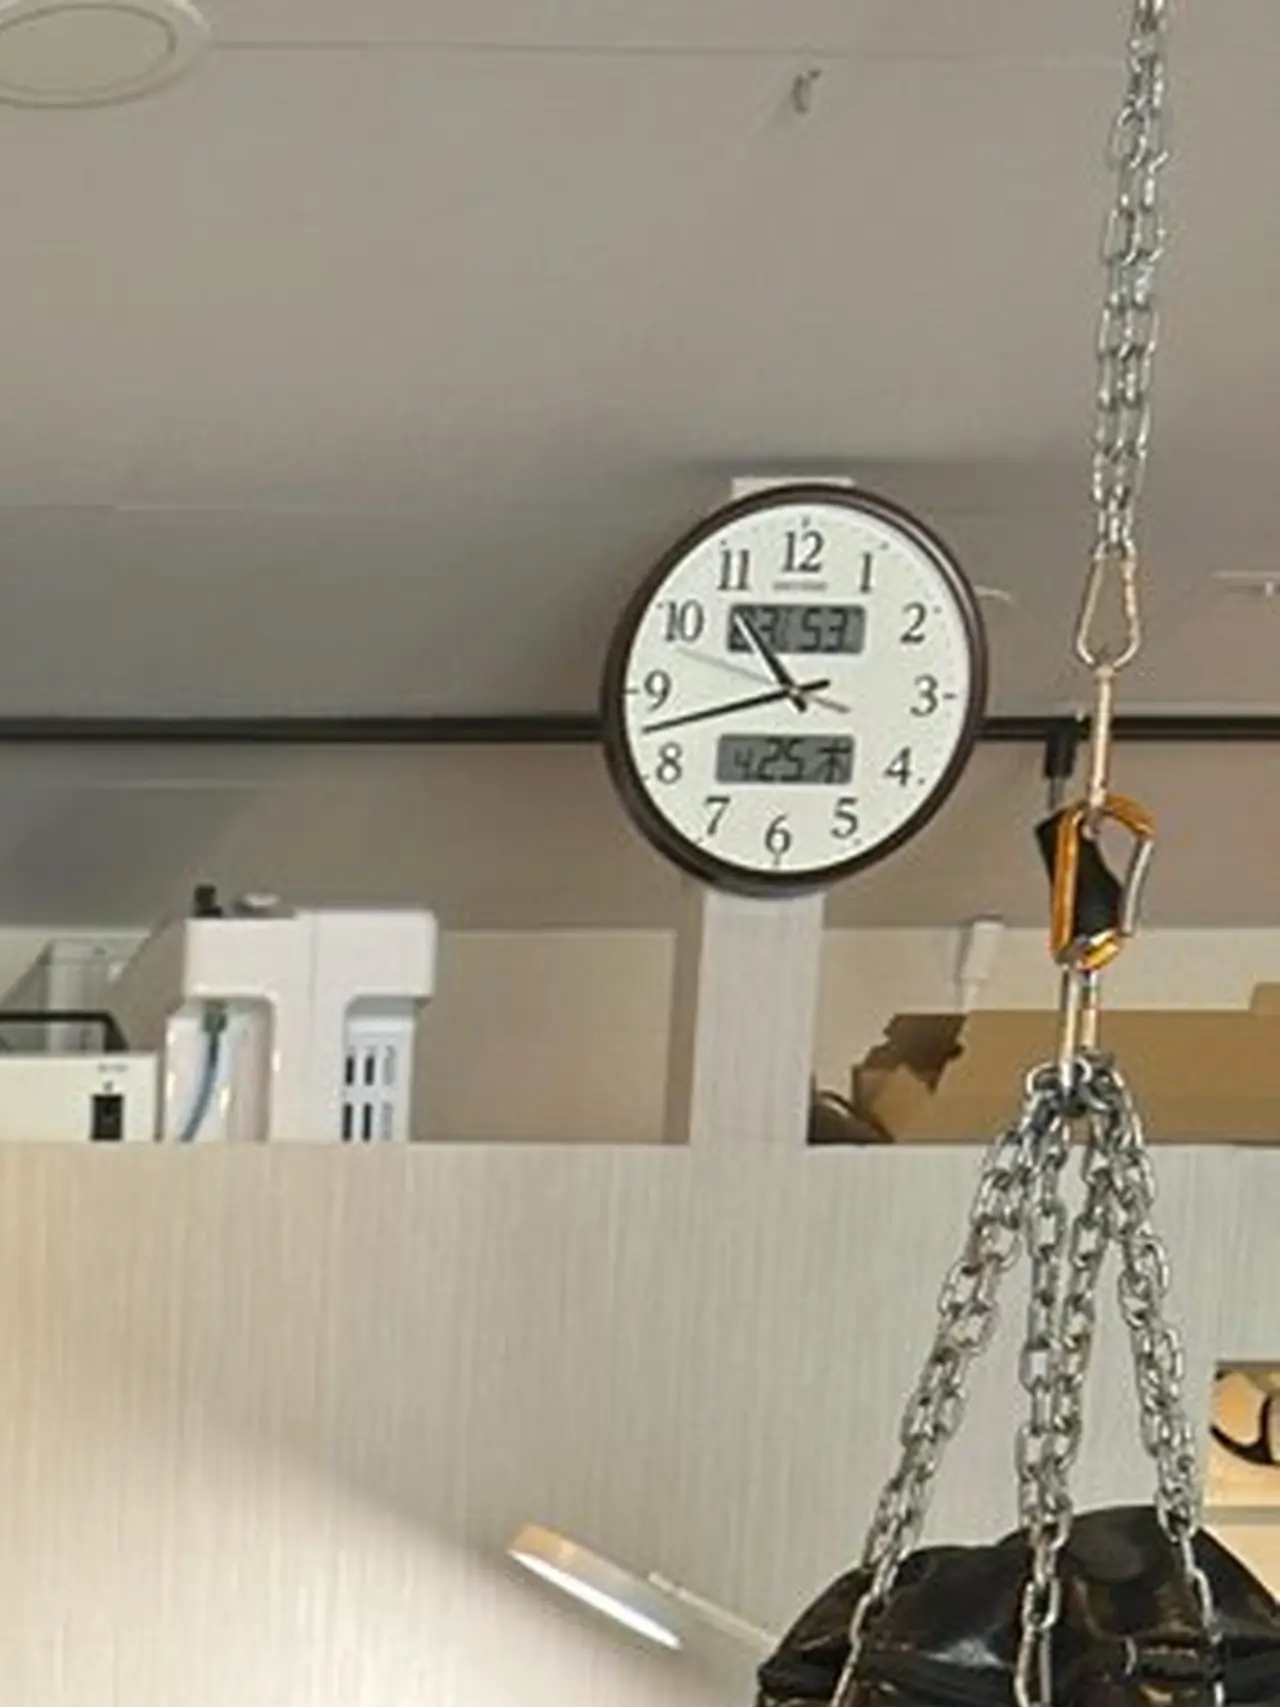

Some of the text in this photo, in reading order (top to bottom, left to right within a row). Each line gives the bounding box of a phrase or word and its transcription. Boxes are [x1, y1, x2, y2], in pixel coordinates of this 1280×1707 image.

[717, 549, 750, 591] 11
[782, 530, 824, 573] 12
[858, 552, 873, 594] 1
[665, 600, 704, 642] 10
[900, 602, 927, 644] 2
[644, 670, 672, 710] 9
[910, 674, 939, 717] 3
[656, 742, 683, 785] 8
[884, 747, 912, 786] 4
[704, 796, 731, 836] 7
[765, 815, 792, 855] 6
[831, 798, 858, 838] 5
